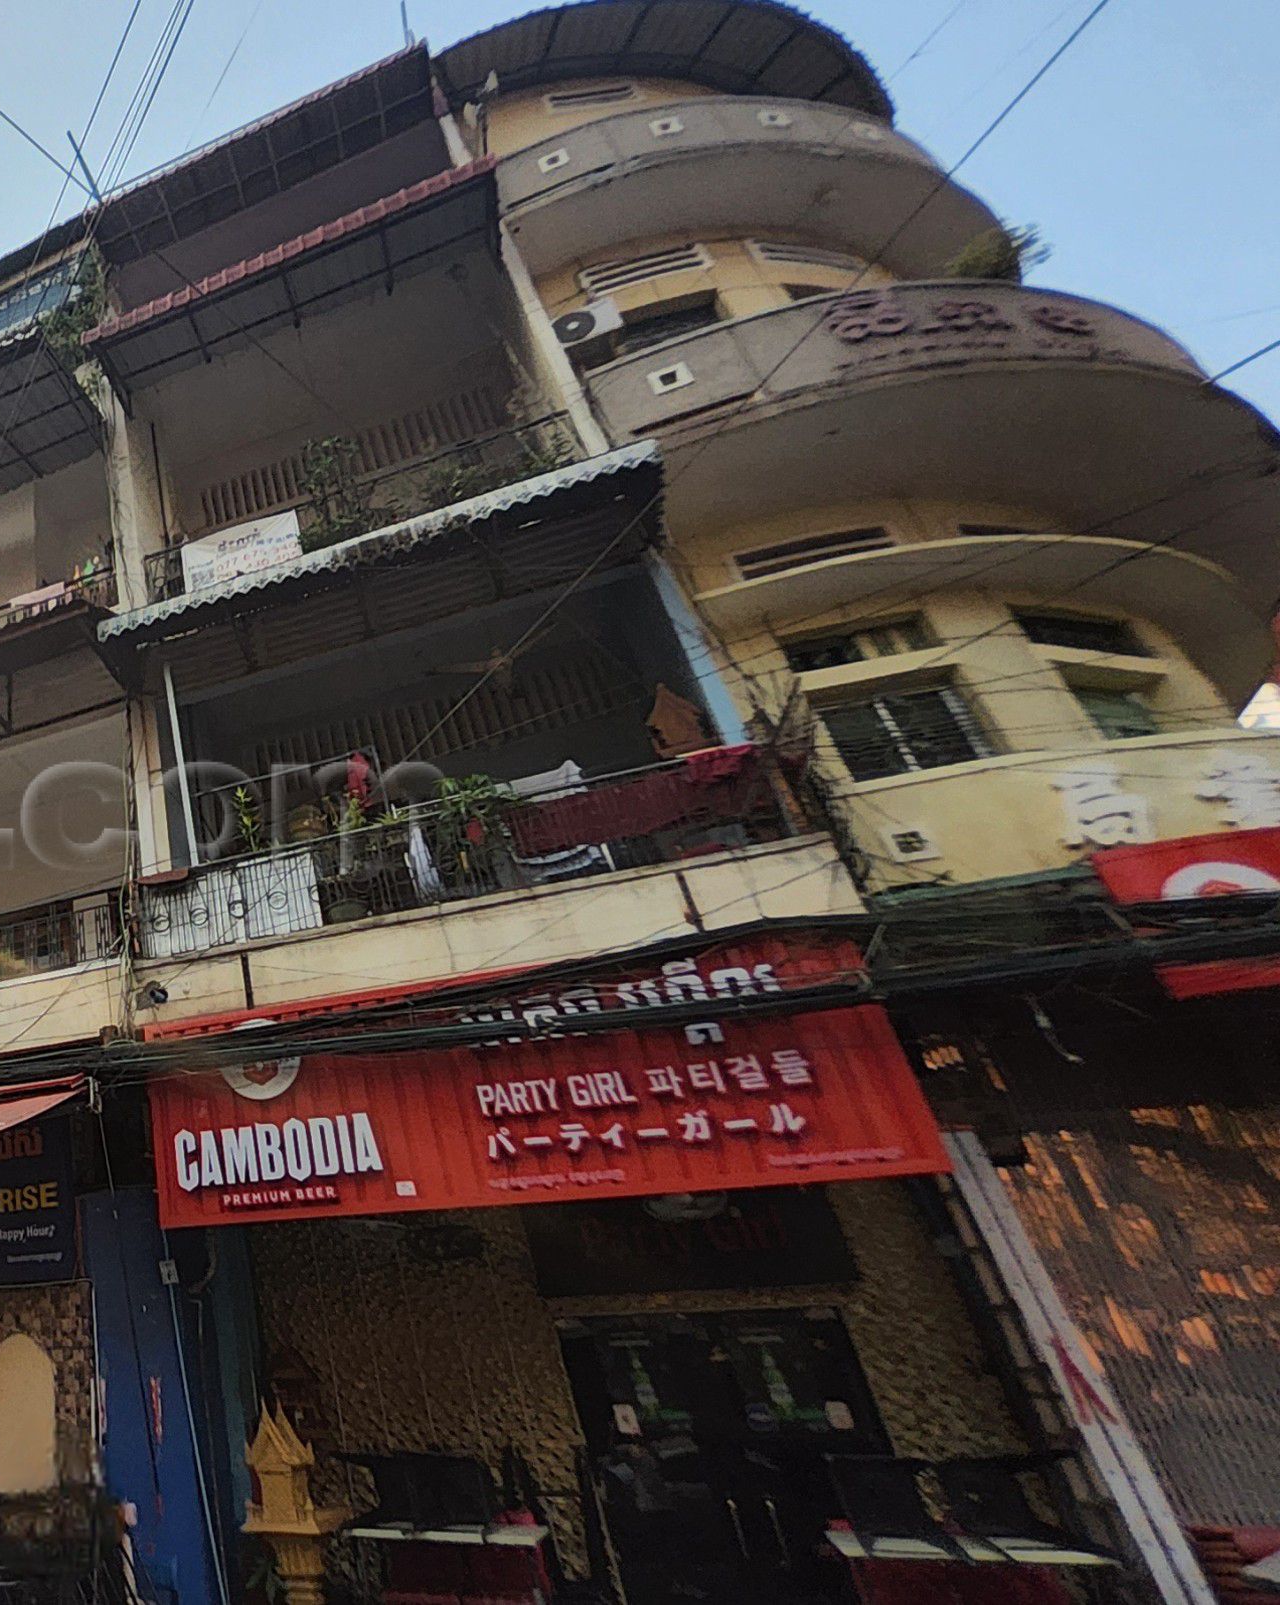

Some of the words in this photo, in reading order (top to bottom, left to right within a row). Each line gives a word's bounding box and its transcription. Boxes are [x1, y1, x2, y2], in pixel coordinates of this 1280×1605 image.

[476, 1078, 561, 1117] PARTY
[567, 1070, 638, 1110] GIRL
[174, 1112, 384, 1192] CAMBODIA
[488, 1103, 806, 1159] パーティーガール
[223, 1189, 292, 1206] PREMIUM
[296, 1186, 336, 1201] BEER
